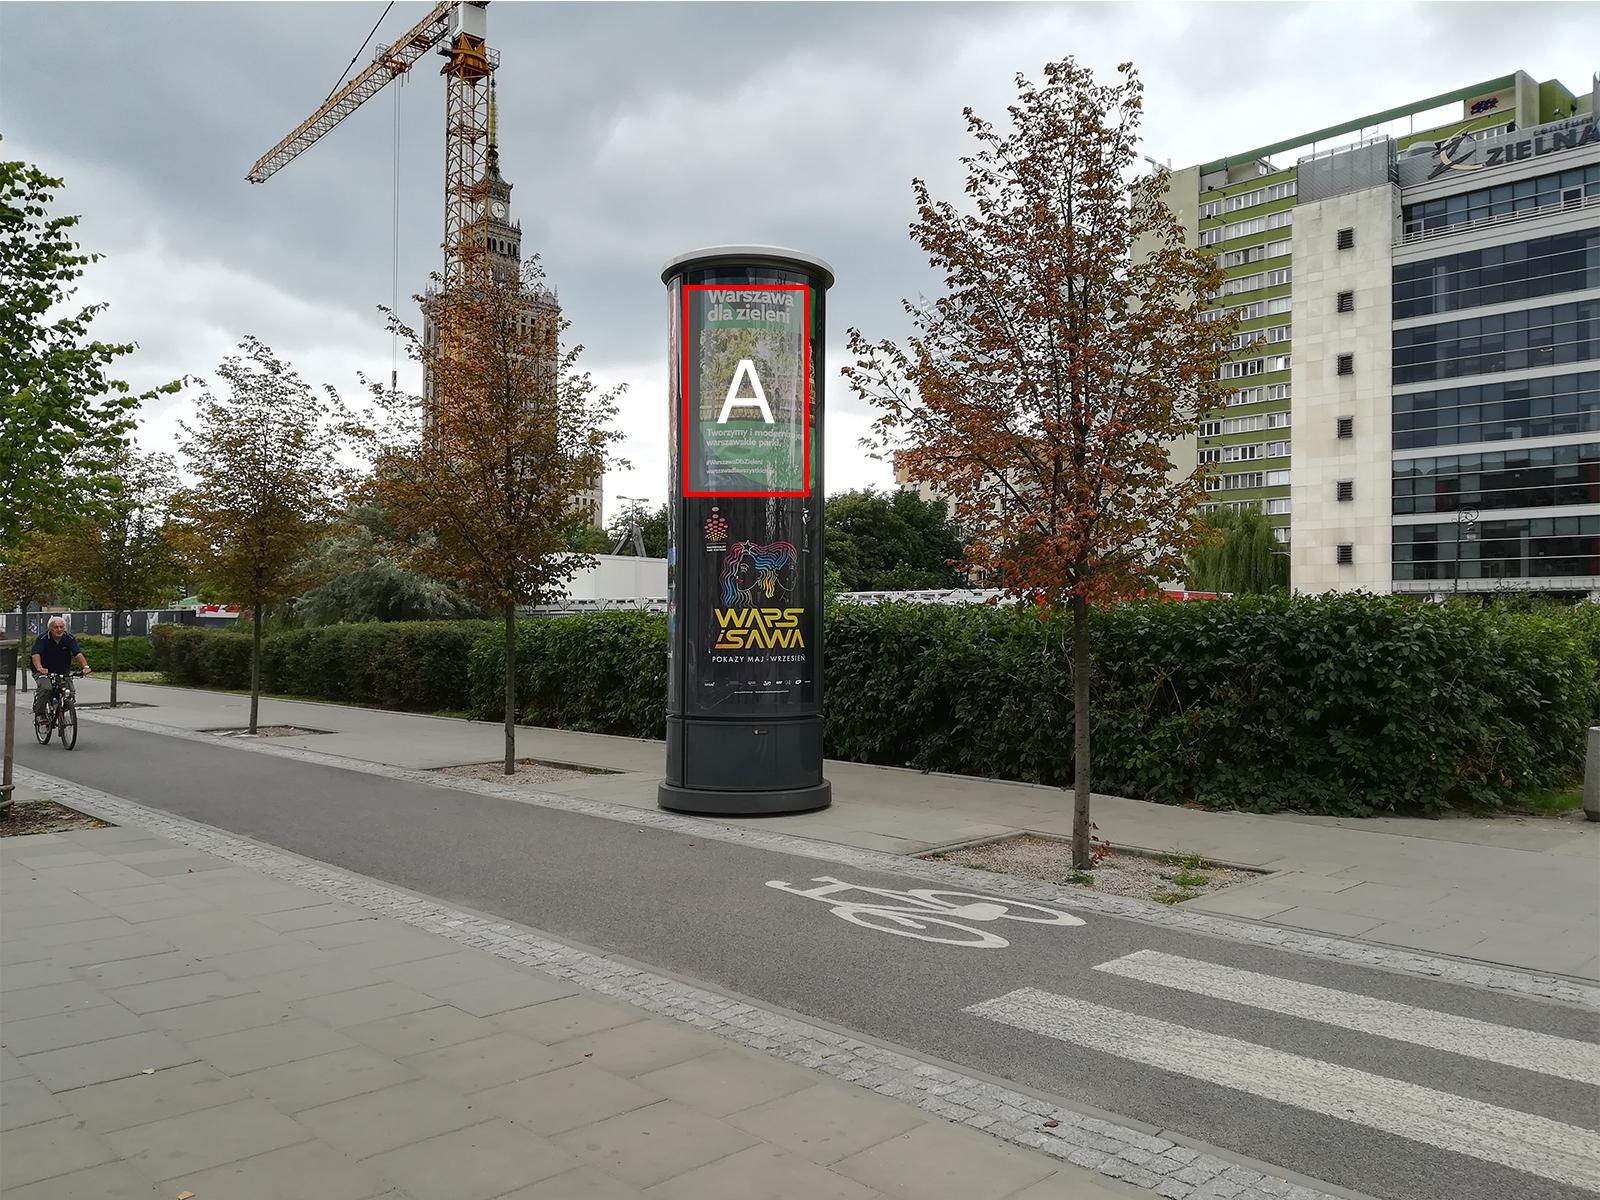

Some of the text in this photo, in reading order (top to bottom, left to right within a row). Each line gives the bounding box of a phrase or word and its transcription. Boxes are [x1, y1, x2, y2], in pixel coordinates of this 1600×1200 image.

[708, 289, 794, 307] Warszawa
[707, 304, 790, 323] dla zieleni
[706, 428, 748, 438] Tworzymy
[706, 438, 756, 447] warszawskie
[714, 608, 805, 628] WARS
[712, 655, 744, 663] POKAZY
[747, 655, 764, 663] MAJ
[770, 653, 806, 662] WRZESIEŃ
